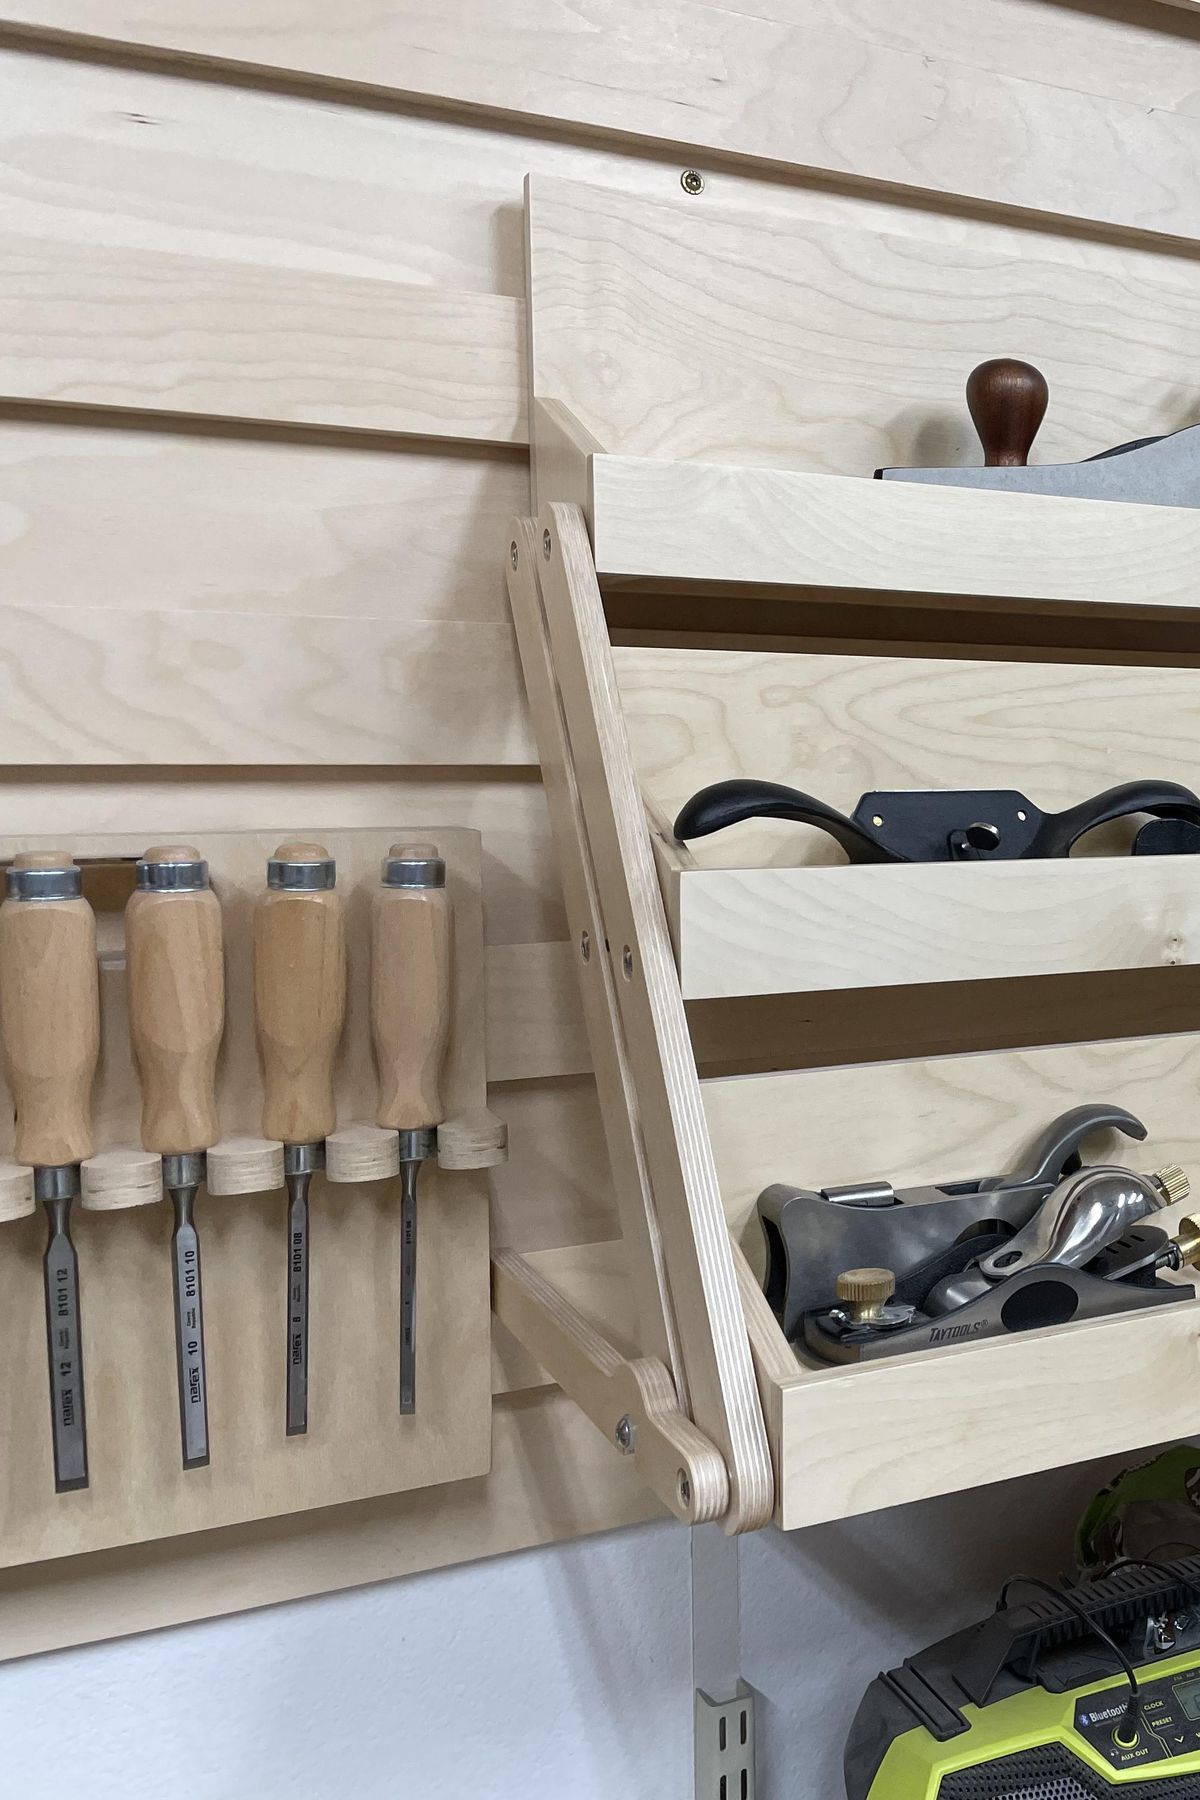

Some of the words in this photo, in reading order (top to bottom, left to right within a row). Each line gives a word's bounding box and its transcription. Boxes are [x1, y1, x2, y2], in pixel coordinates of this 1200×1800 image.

[184, 1250, 195, 1265] 10
[293, 1248, 302, 1273] 8101
[56, 1268, 68, 1283] 12
[185, 1268, 196, 1297] 8101
[58, 1287, 69, 1317] 8101
[187, 1340, 198, 1356] 10
[292, 1333, 303, 1365] narex
[60, 1361, 72, 1377] 12
[188, 1366, 202, 1404] narex
[62, 1388, 75, 1427] narex
[1088, 1702, 1128, 1723] Bluetooth
[1143, 1701, 1164, 1711] CLOCK
[1151, 1716, 1173, 1727] PRESET
[1120, 1752, 1135, 1762] AUX
[1135, 1748, 1149, 1757] OUT
